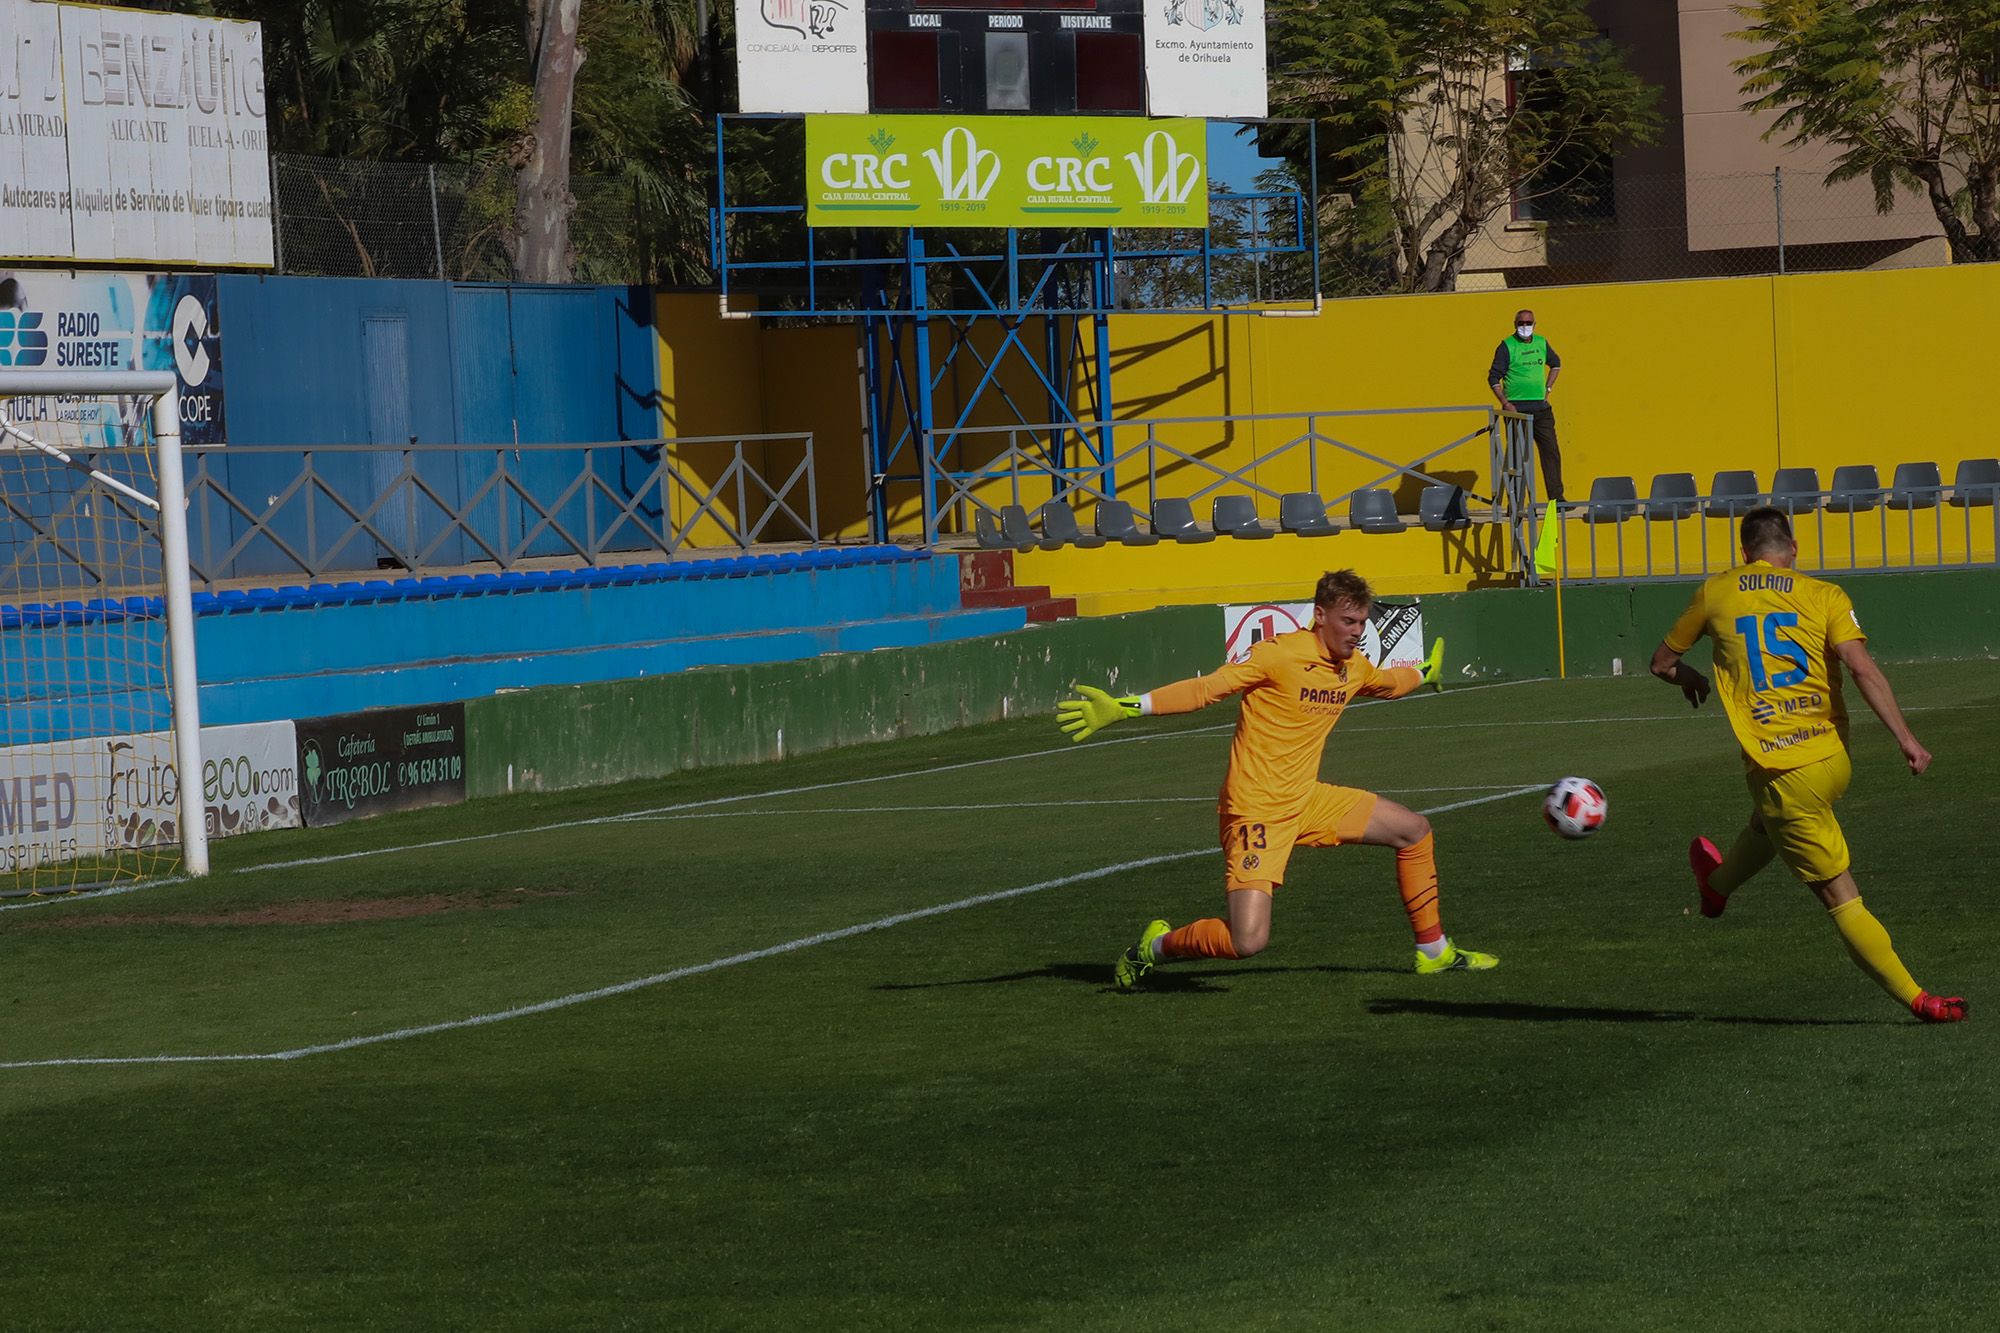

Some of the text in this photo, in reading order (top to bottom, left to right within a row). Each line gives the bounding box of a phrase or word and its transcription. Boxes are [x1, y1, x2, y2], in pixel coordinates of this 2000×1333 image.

[909, 14, 941, 27] LOCAL
[988, 15, 1023, 28] PERIODO
[1061, 15, 1111, 28] VISITANTE
[812, 45, 856, 53] DEPORTES
[1156, 40, 1253, 51] Excmo. Ayuntamiento
[1178, 53, 1231, 63] de Orihuela
[18, 113, 66, 137] MURAD
[110, 119, 168, 144] ALICANTE
[822, 153, 910, 189] CRC
[1027, 156, 1113, 192] CRC
[2, 184, 57, 209] Autocares
[116, 190, 128, 210] de
[130, 188, 170, 212] Servicio
[172, 190, 184, 213] de
[844, 193, 870, 201] RURAL
[872, 193, 910, 201] CENTRAL
[1027, 195, 1113, 204] CAJA RURAL CENTRAL
[58, 312, 100, 337] RADIO
[57, 342, 118, 366] SURESTE
[81, 410, 88, 420] DE
[179, 395, 212, 422] COPE
[1739, 574, 1793, 593] SOLANO
[1735, 612, 1810, 693] 15
[1779, 694, 1822, 713] IMED
[338, 733, 376, 763] Cafetería
[1760, 727, 1809, 753] Orihuela
[408, 755, 461, 786] 96 634 31 09
[327, 761, 391, 809] TREBOL
[0, 772, 75, 836] MED
[1239, 823, 1266, 851] 13
